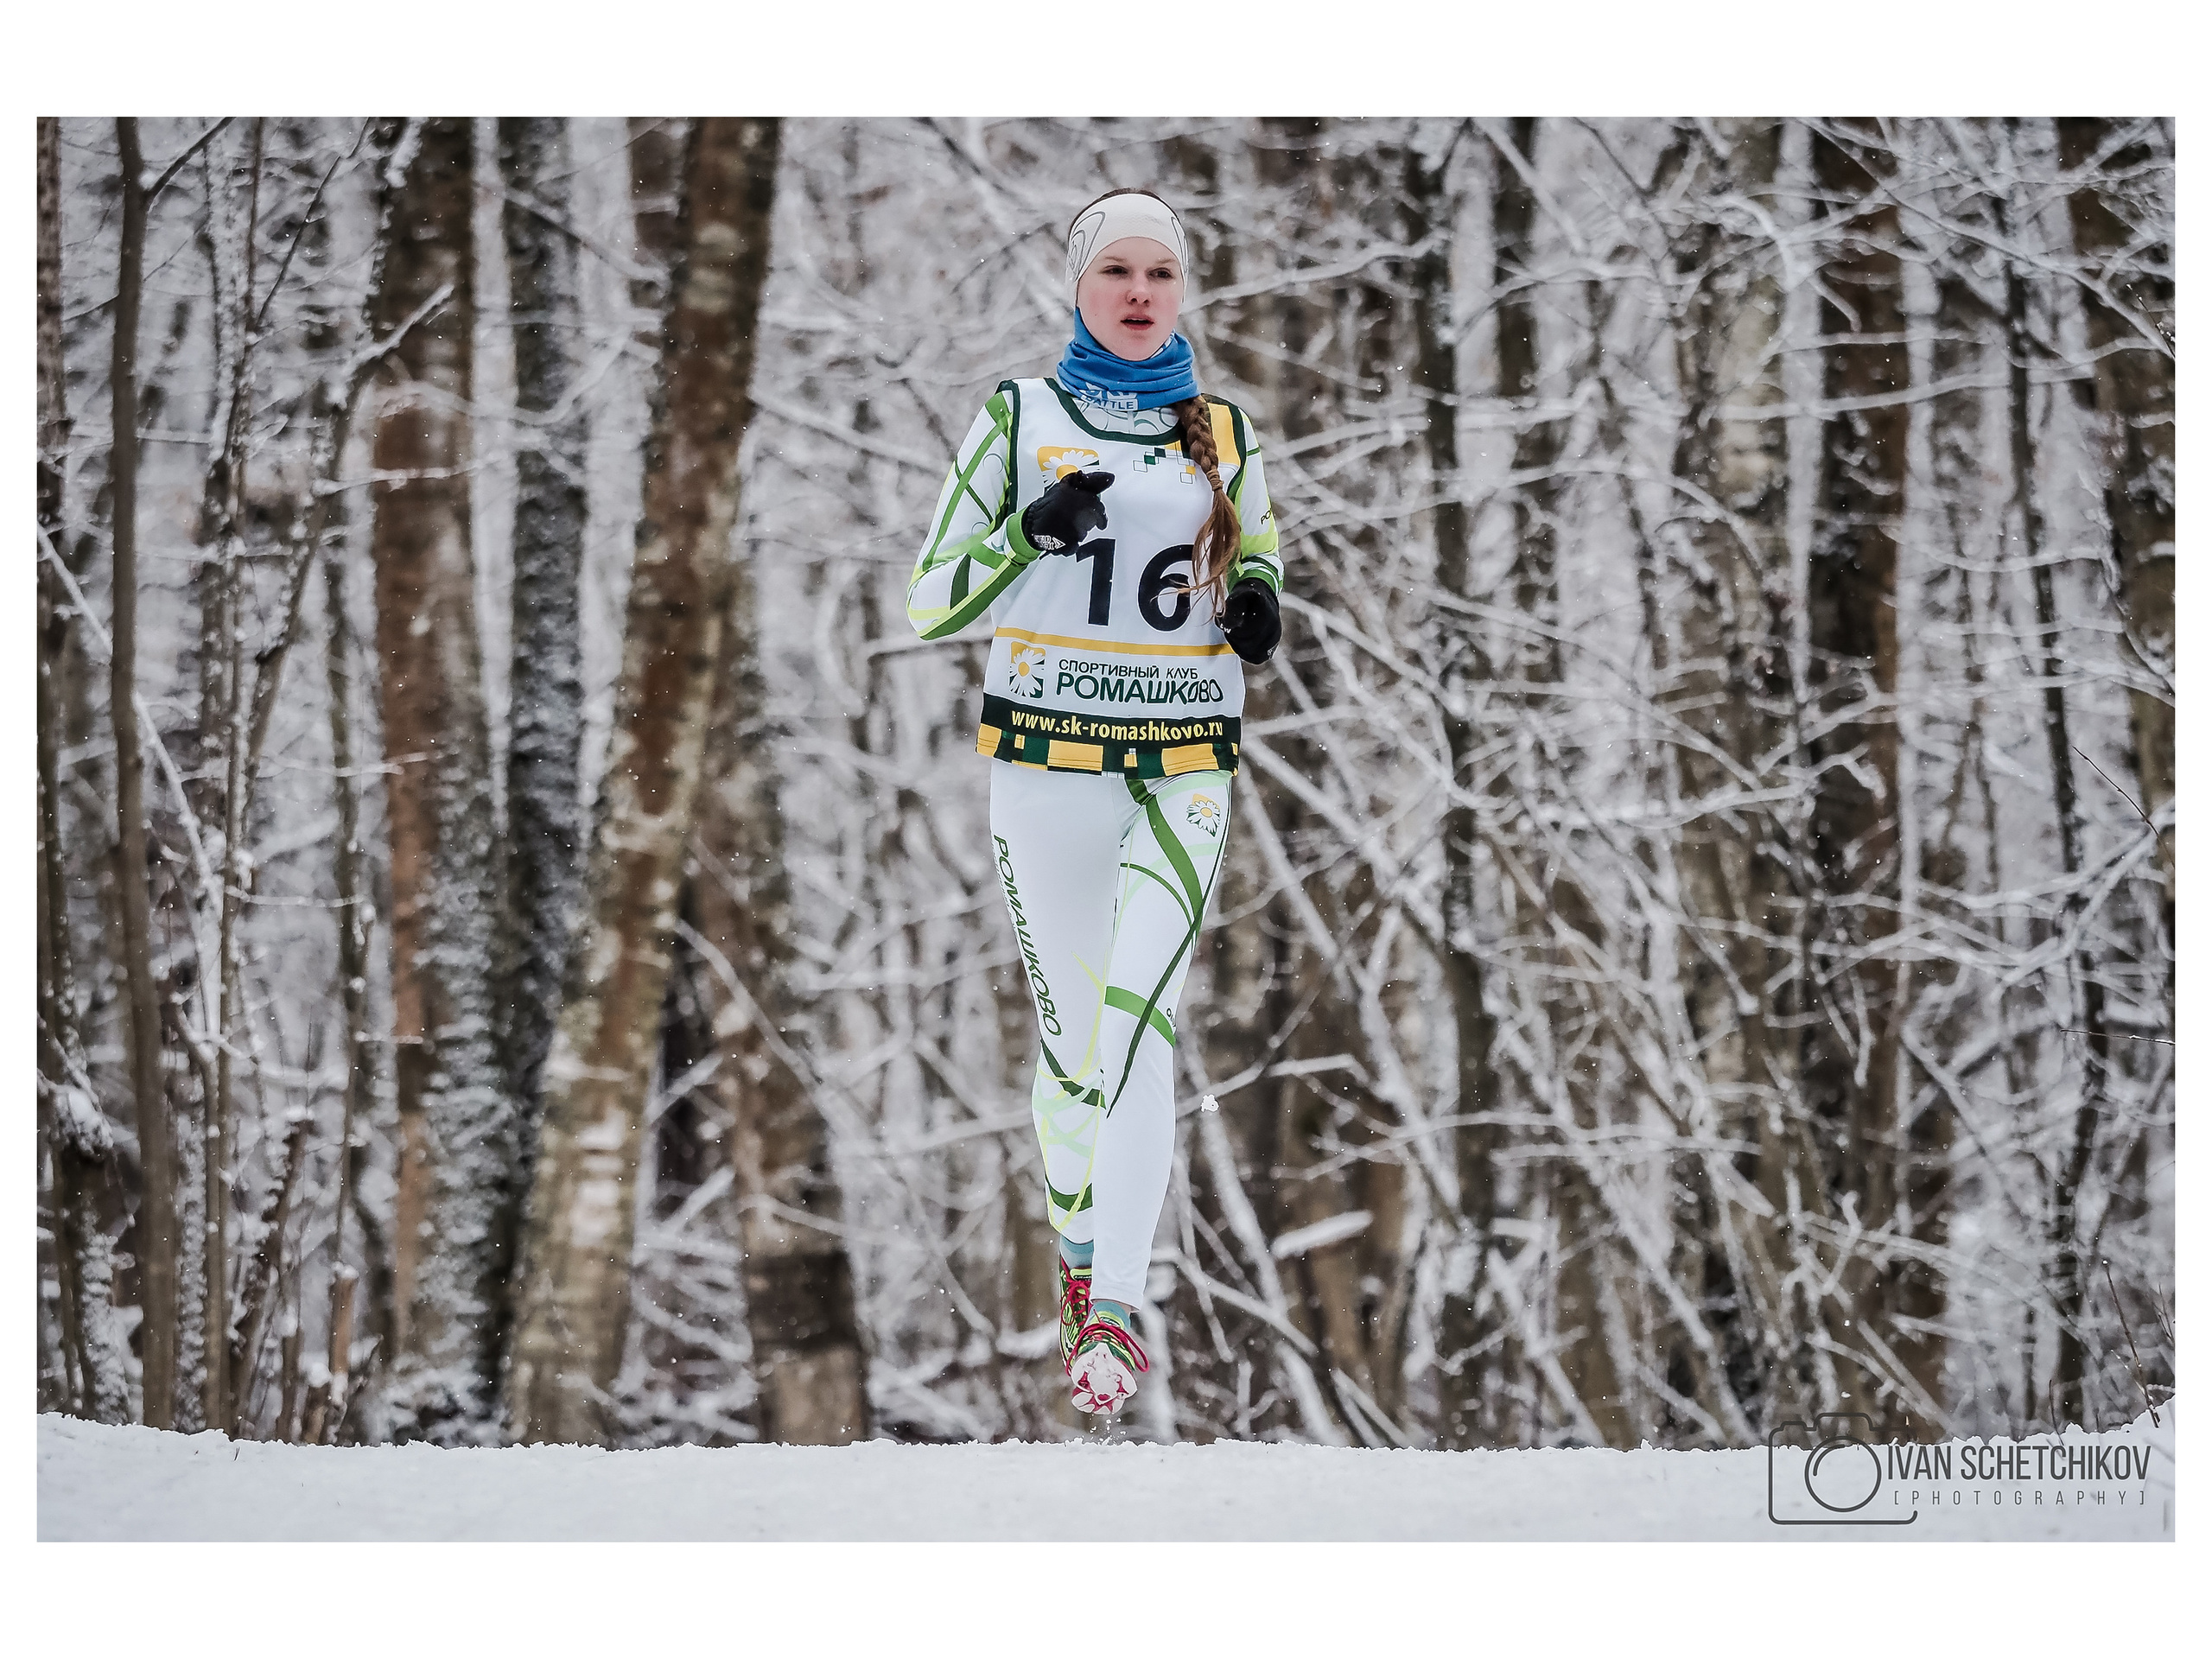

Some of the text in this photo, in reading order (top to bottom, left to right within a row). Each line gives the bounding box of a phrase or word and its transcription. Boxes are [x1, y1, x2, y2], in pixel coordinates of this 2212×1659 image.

[1076, 537, 1195, 632] 16
[1058, 658, 1198, 680] СПОРТИВНЫЙ КЛУБ
[1056, 671, 1224, 705] РОМАШКОВО
[1011, 710, 1224, 741] www.sk-romashkovo.ru
[993, 834, 1062, 1036] РОМАШКОВО
